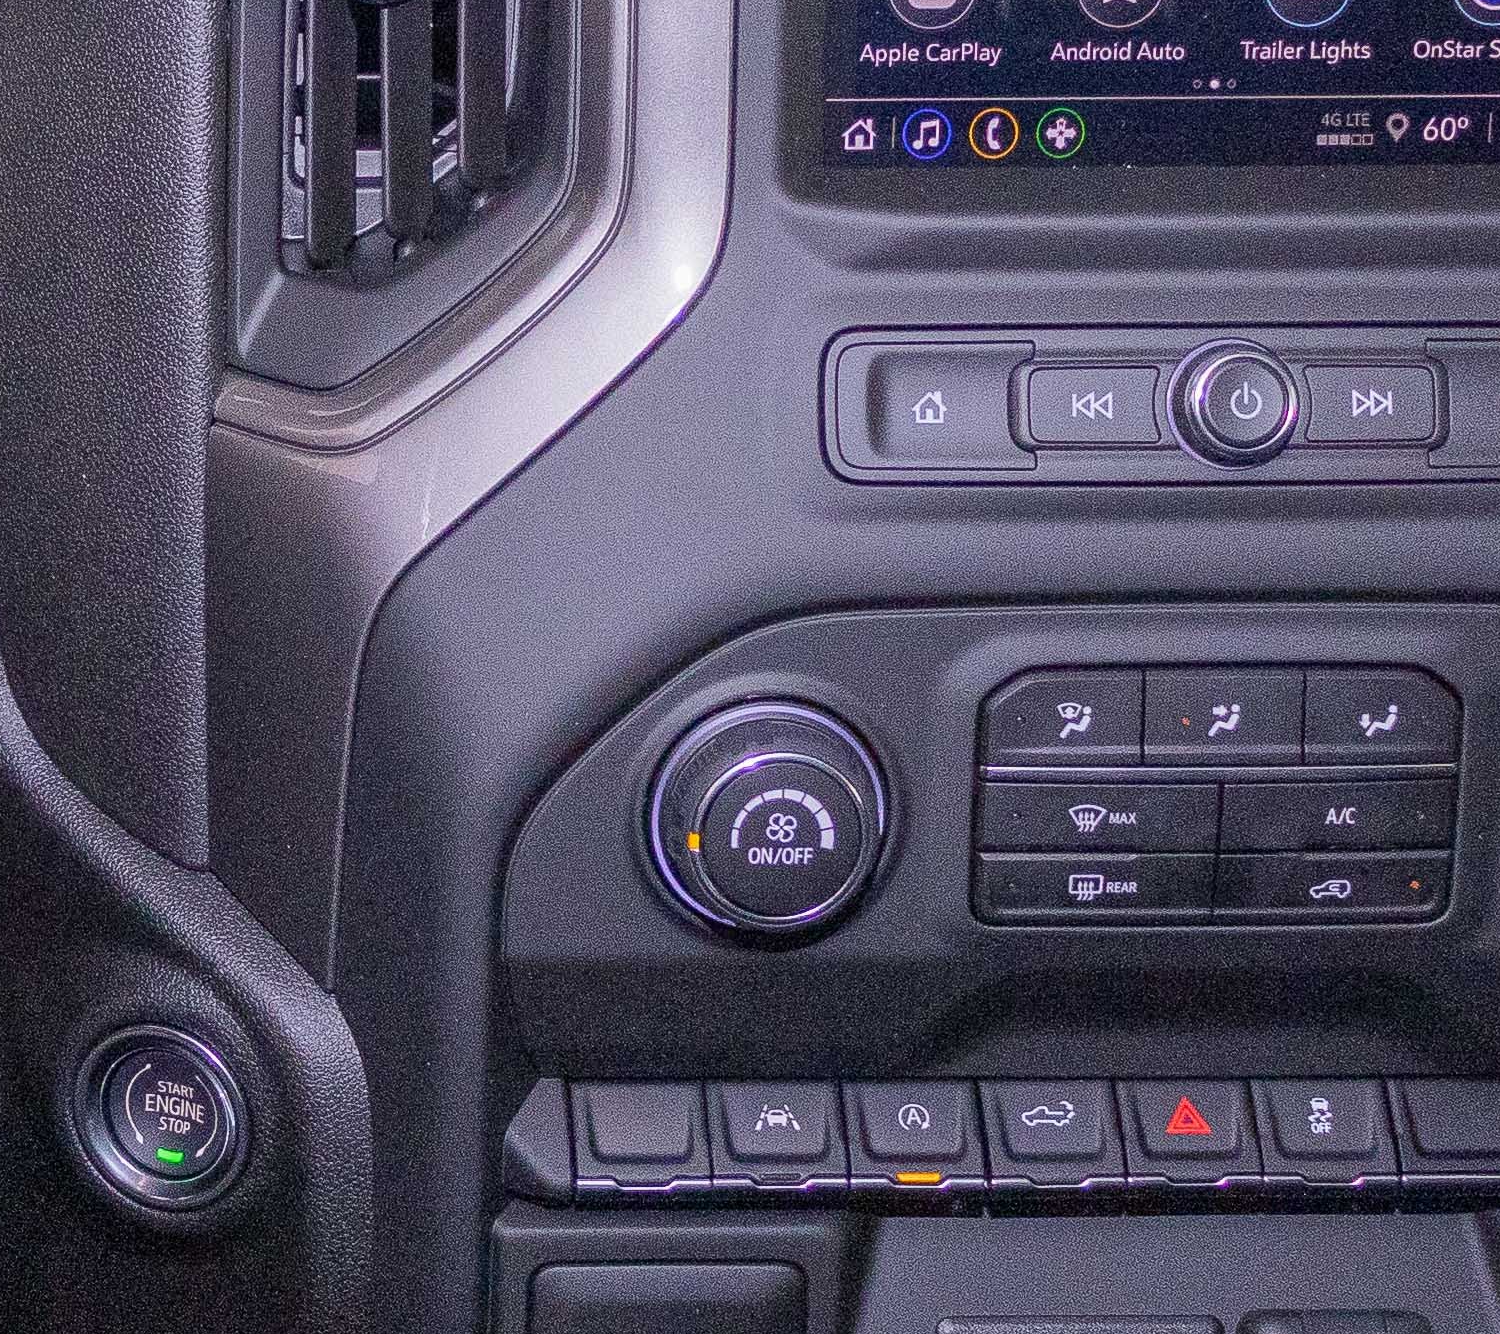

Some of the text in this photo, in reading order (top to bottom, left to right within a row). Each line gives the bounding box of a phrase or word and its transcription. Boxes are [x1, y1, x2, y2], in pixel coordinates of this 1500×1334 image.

[860, 42, 1002, 67] Apple CarPlay
[1050, 41, 1186, 61] Android Auto
[1240, 40, 1372, 64] Trailer Lights
[1413, 39, 1485, 59] OnStar
[1320, 113, 1371, 128] 4G LTE
[1108, 811, 1137, 826] MAX
[1324, 805, 1357, 827] A/C
[747, 845, 814, 866] ON/OFF
[1106, 879, 1138, 895] REAR
[156, 1079, 195, 1100] START
[144, 1093, 205, 1124] ENGINE
[159, 1116, 191, 1135] STOP
[1310, 1122, 1332, 1134] OFF
